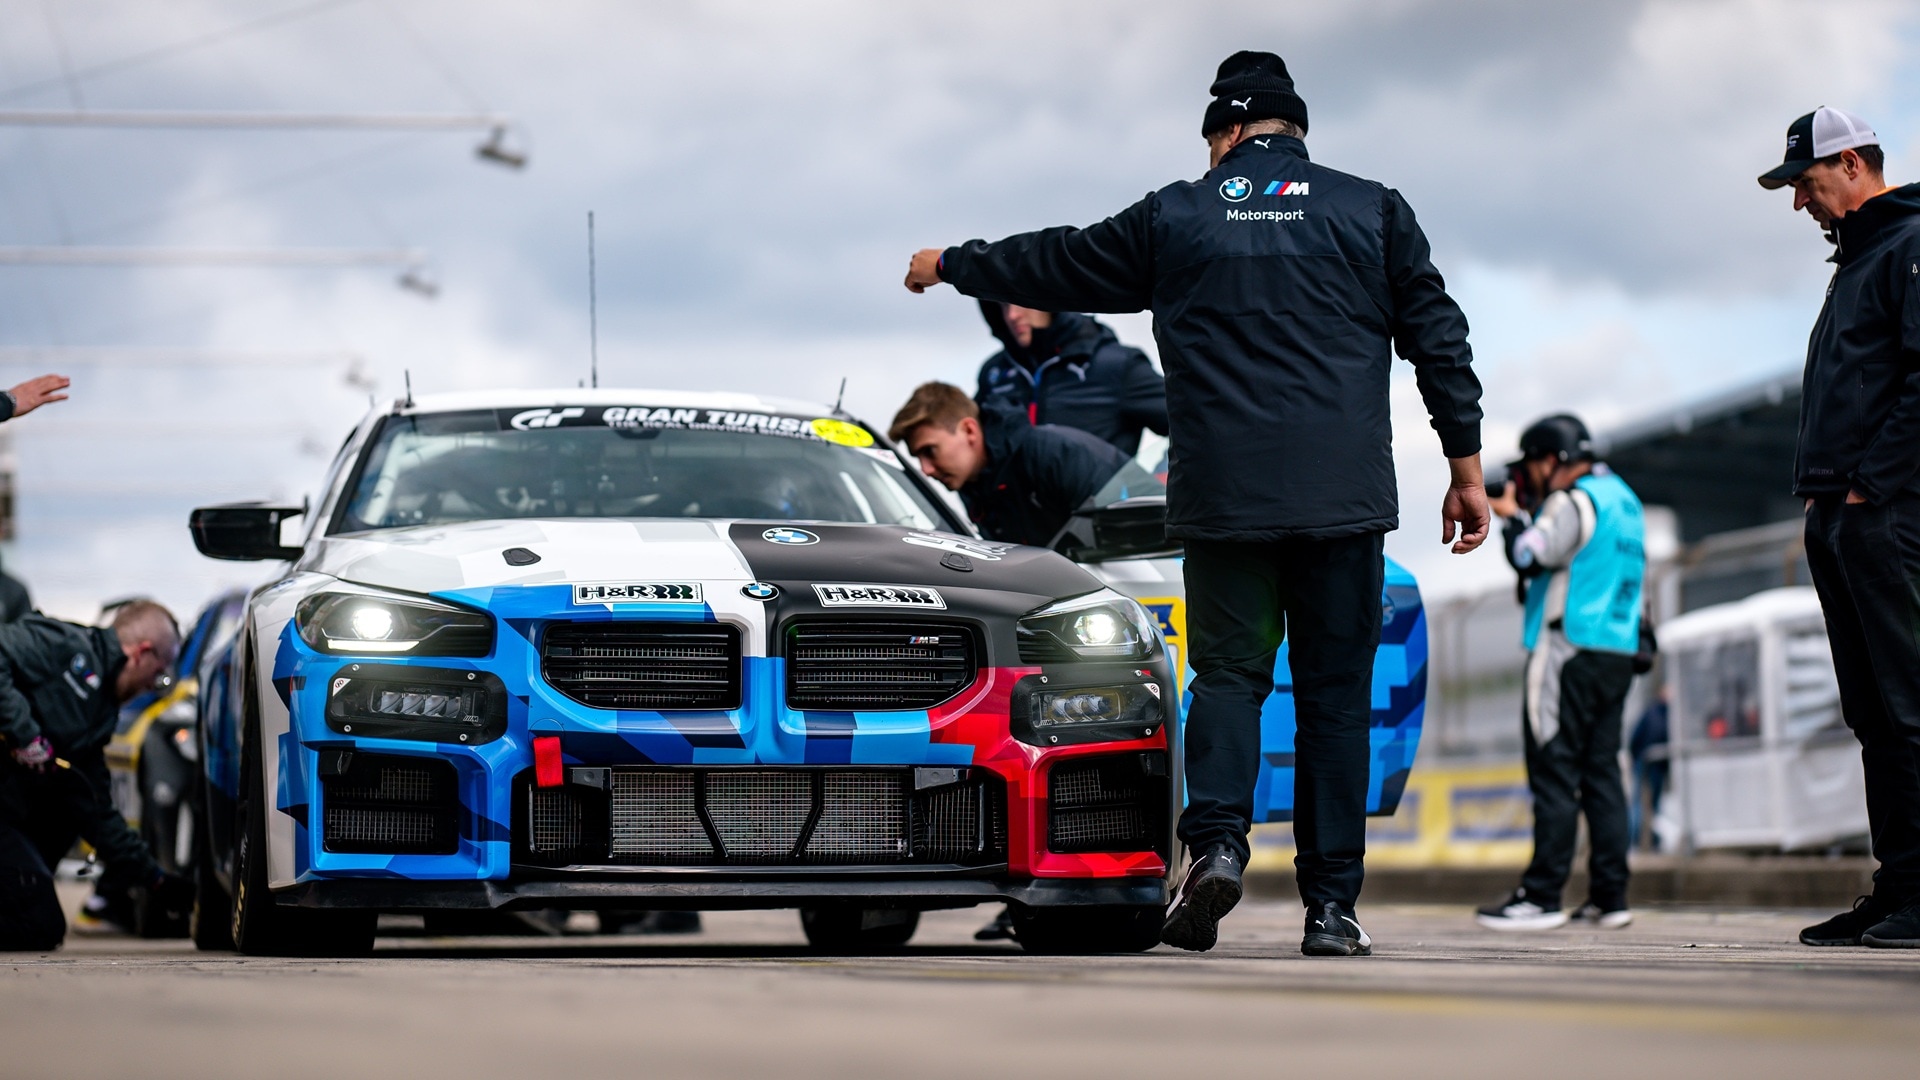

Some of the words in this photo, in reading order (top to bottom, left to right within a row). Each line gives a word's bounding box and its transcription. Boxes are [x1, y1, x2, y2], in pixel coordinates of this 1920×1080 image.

[1226, 209, 1304, 222] Motorsport
[602, 407, 698, 424] GRAN
[706, 410, 815, 434] TURIS
[580, 585, 653, 600] H&R
[822, 587, 892, 602] H&R
[917, 636, 939, 644] M2
